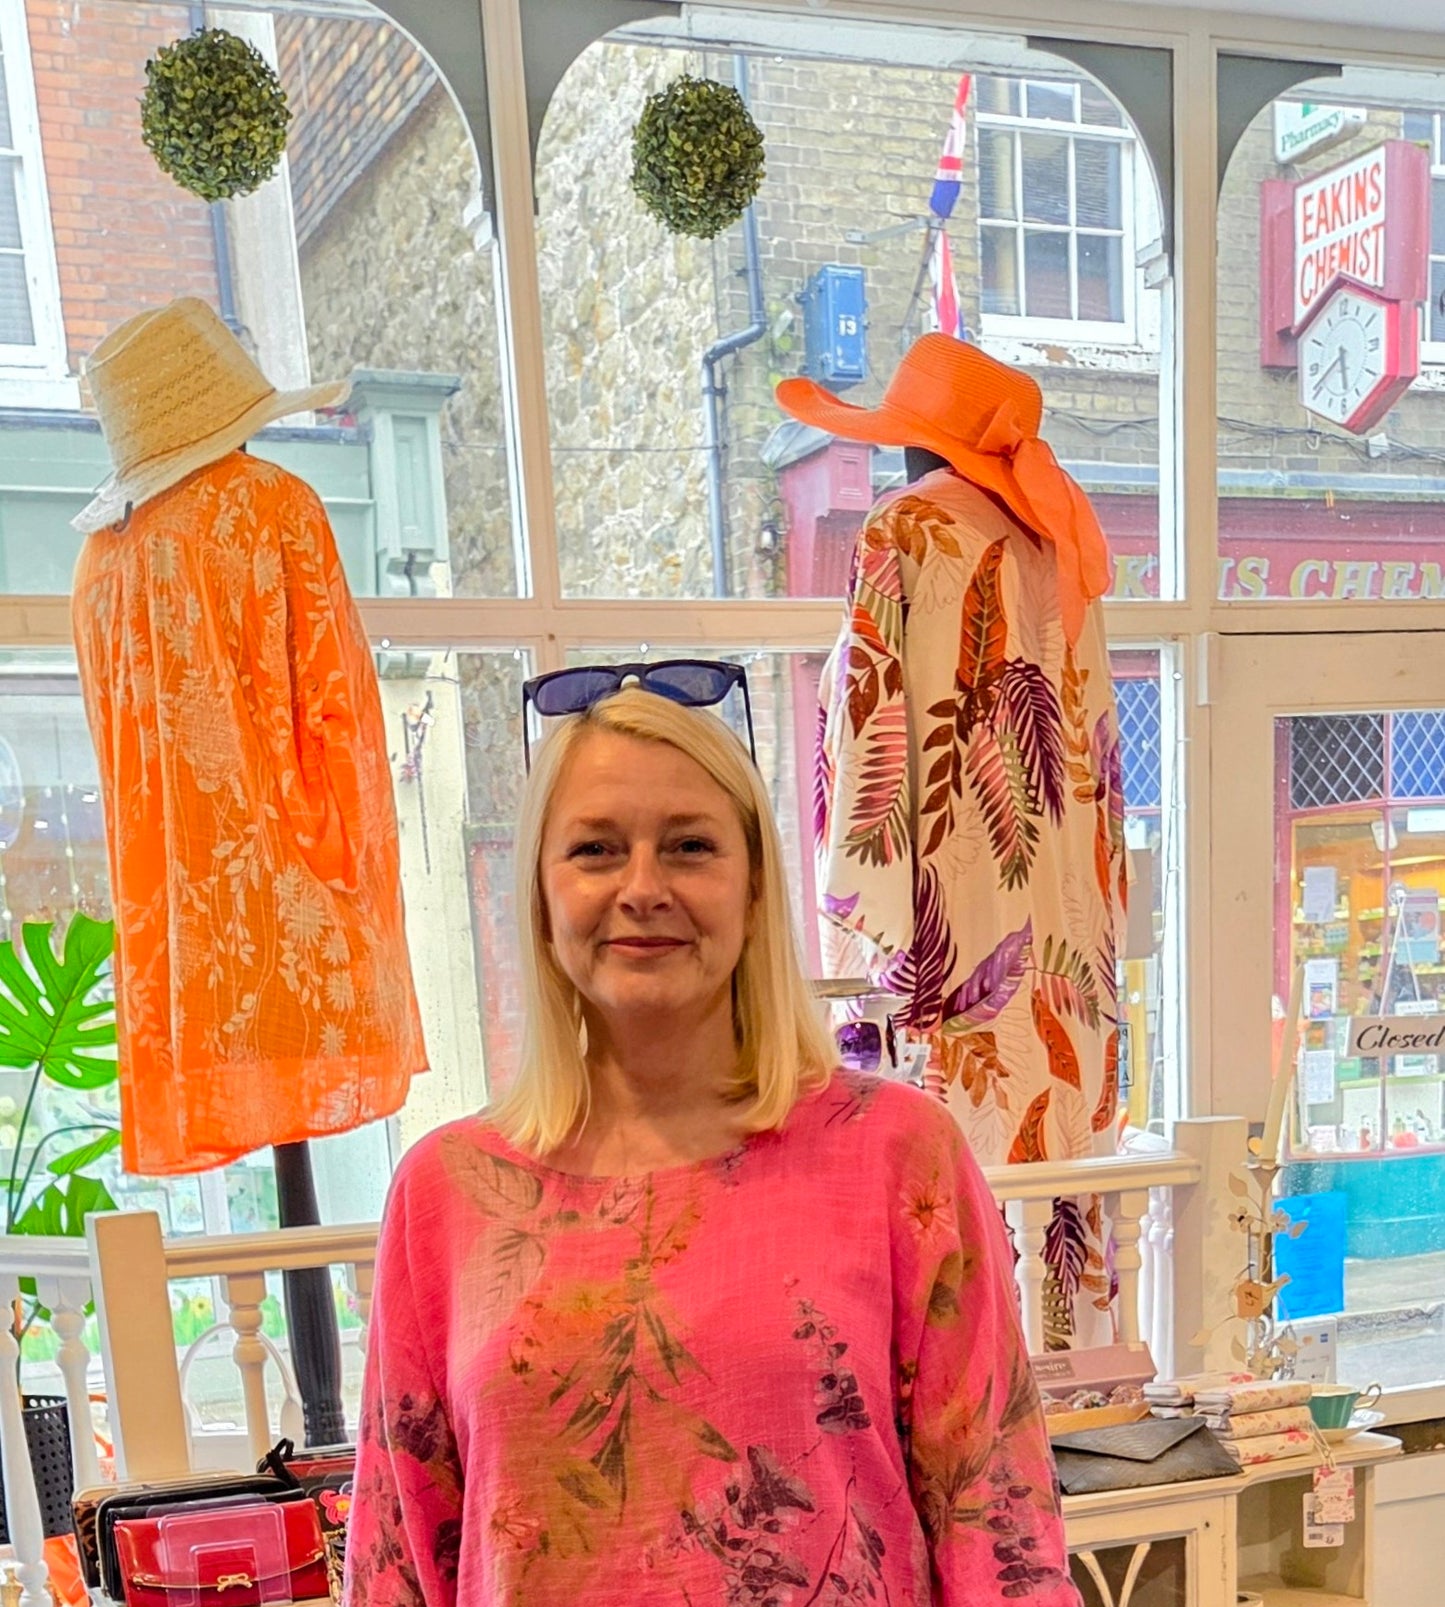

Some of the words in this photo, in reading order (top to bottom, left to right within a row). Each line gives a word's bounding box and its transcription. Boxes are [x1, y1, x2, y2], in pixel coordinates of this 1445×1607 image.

[1281, 110, 1341, 153] Pharmacy
[1302, 161, 1382, 245] EAKINS
[1300, 220, 1385, 307] CHEMIST
[1356, 1024, 1445, 1051] Closed
